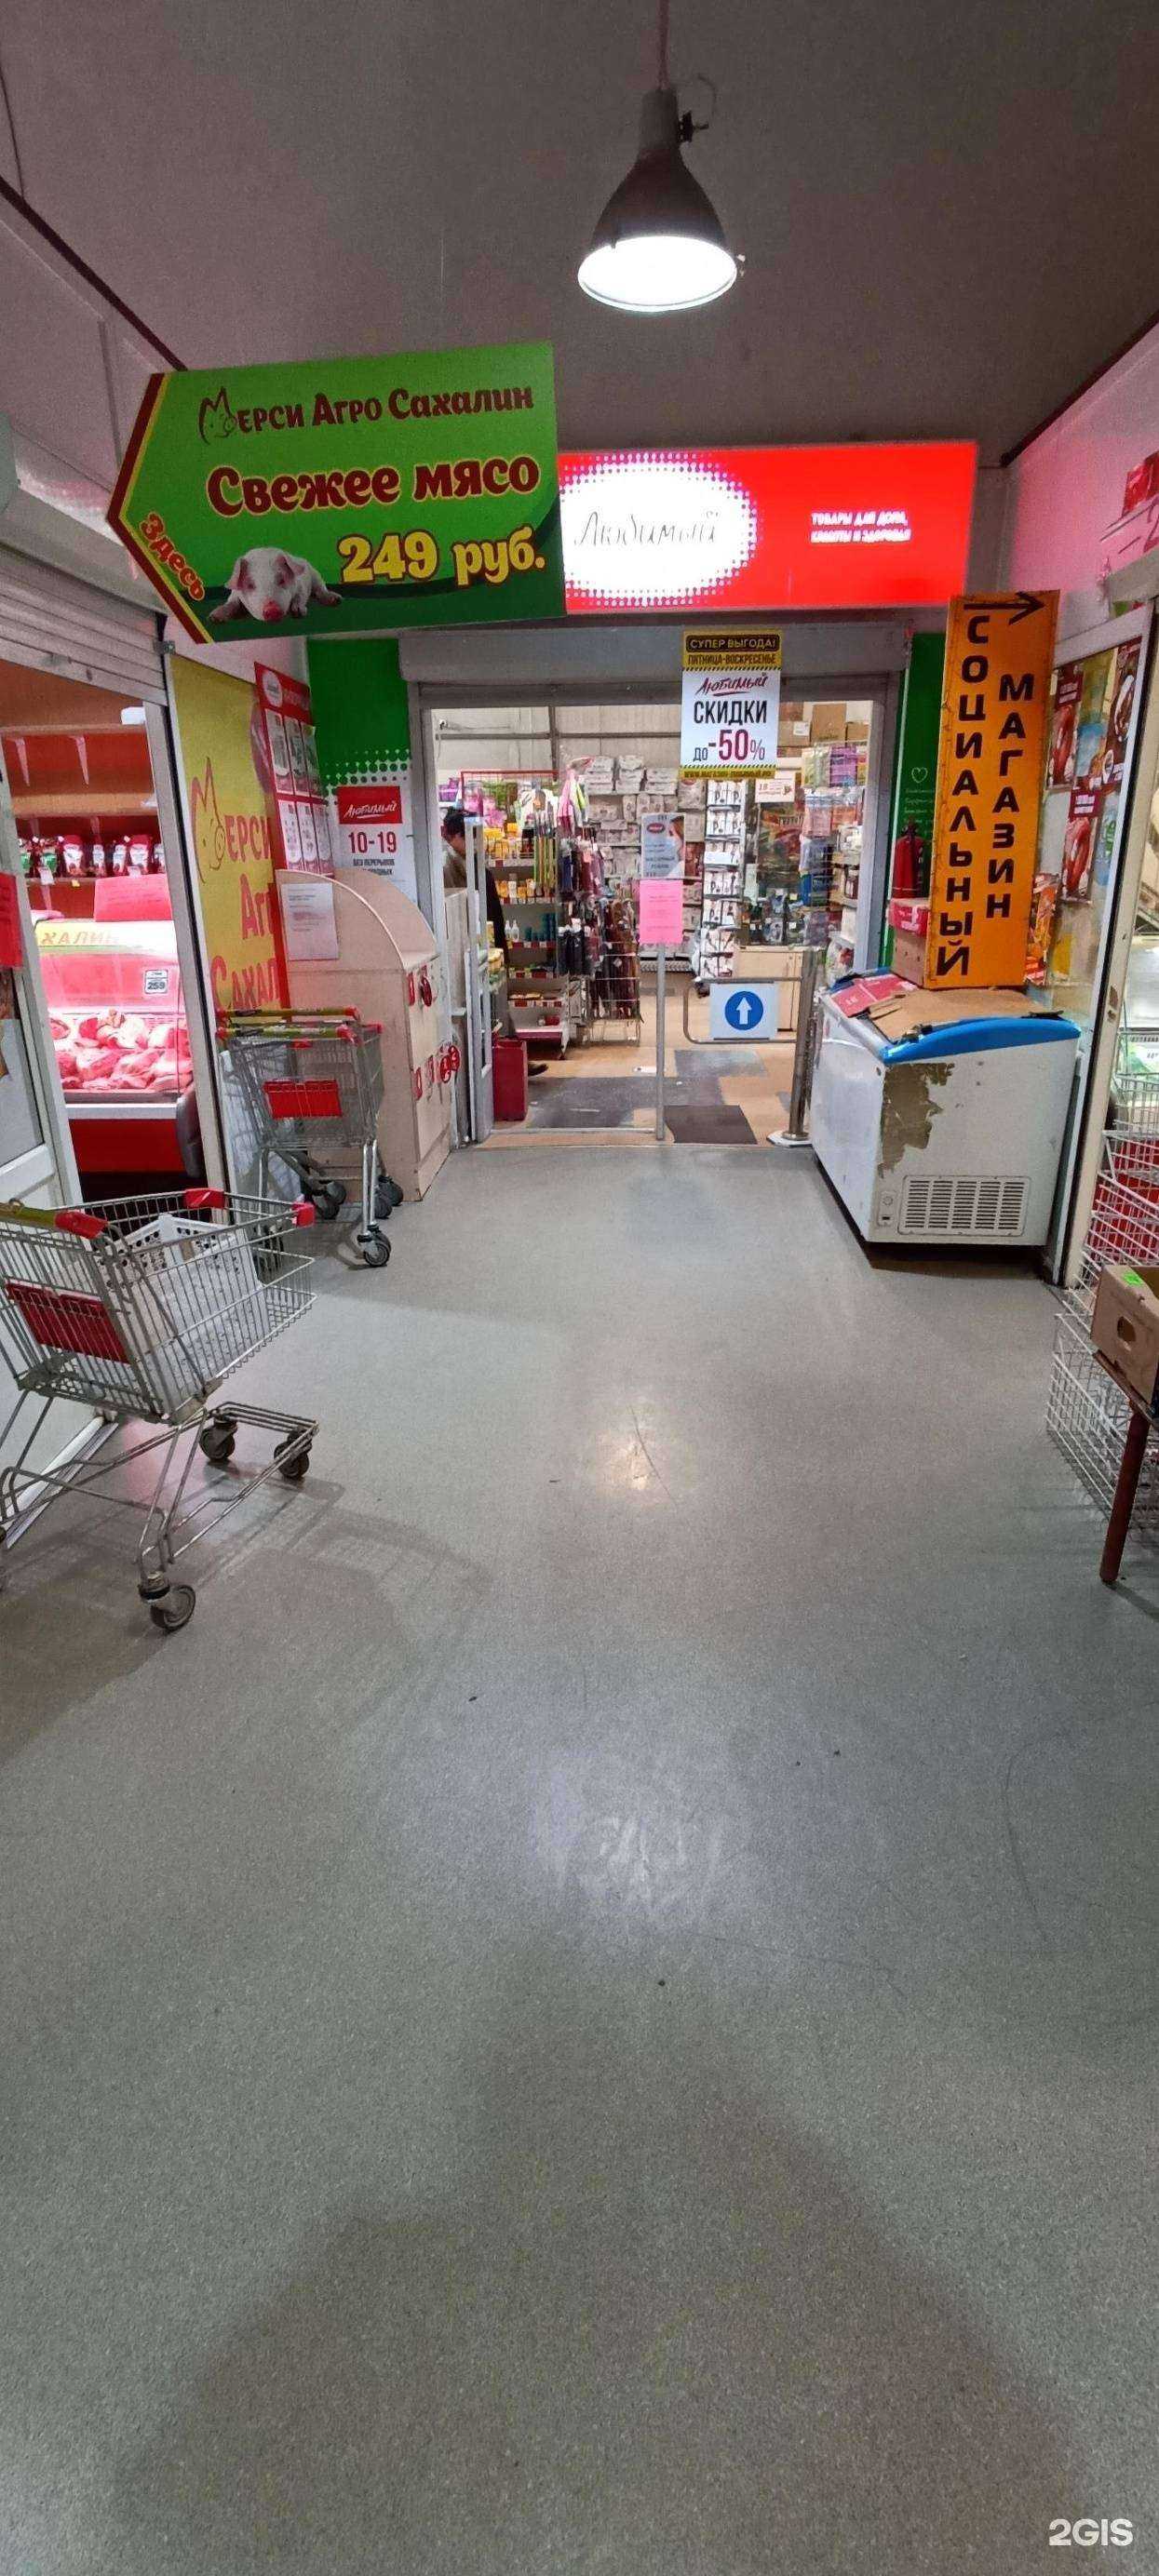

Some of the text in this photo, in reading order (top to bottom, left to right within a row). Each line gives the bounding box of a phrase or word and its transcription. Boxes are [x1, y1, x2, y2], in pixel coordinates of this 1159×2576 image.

[388, 387, 534, 420] Сахалин
[207, 456, 541, 517] Свежее мясо
[574, 511, 719, 547] Любимый
[140, 512, 205, 600] Здесь
[338, 525, 546, 587] 249 руб.
[688, 653, 775, 665] ПЯТНИЦА-ВОСКРЕСЕНЬЕ
[690, 638, 776, 650] СУПЕР ВЫГОДА!
[695, 673, 769, 695] Любимый
[694, 700, 767, 726] СКИДКИ
[708, 729, 765, 761] -50%
[936, 614, 991, 977] СОЦИАЛЬНЫЙ
[985, 672, 1034, 919] МАГАЗИН
[348, 831, 398, 853] 10-19
